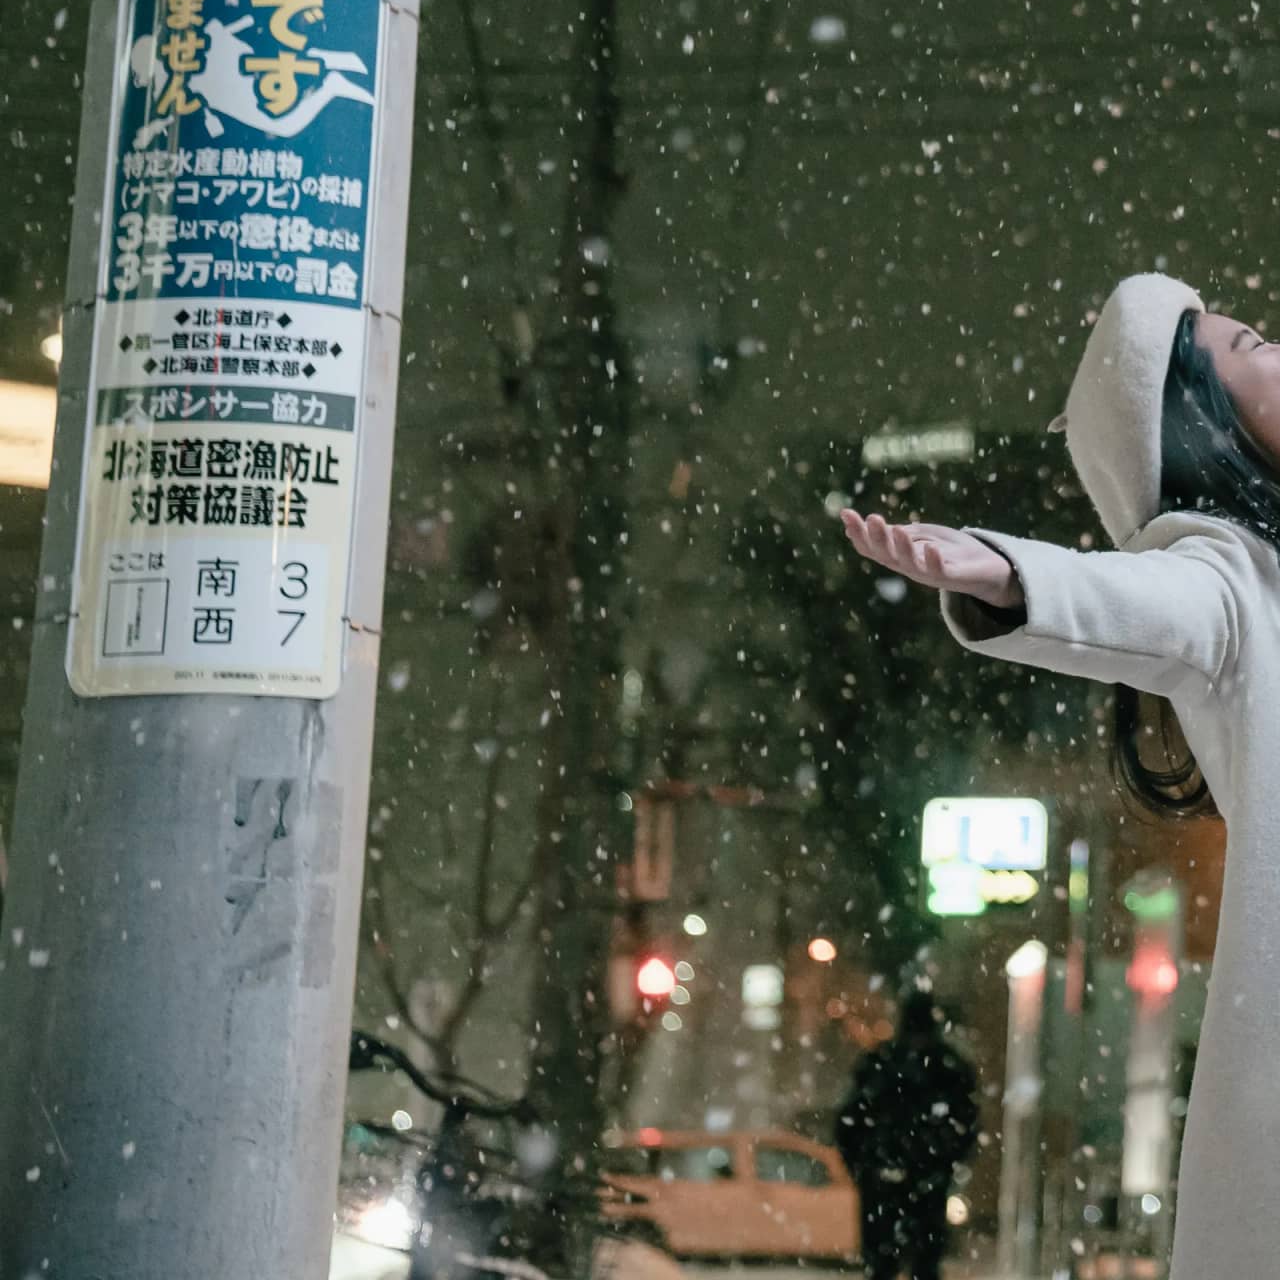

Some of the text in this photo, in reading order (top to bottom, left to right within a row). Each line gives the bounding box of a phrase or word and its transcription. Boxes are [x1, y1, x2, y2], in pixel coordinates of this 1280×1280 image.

[123, 147, 303, 180] 特定水産動植物
[113, 252, 358, 300] 3千万円以下の罰金
[123, 387, 328, 425] スポンサー協力
[103, 436, 340, 486] 北海道密漁防止
[130, 483, 308, 528] 対策協議会
[110, 552, 164, 571] ここは
[197, 556, 309, 600] 南 3
[193, 606, 307, 647] 西 7
